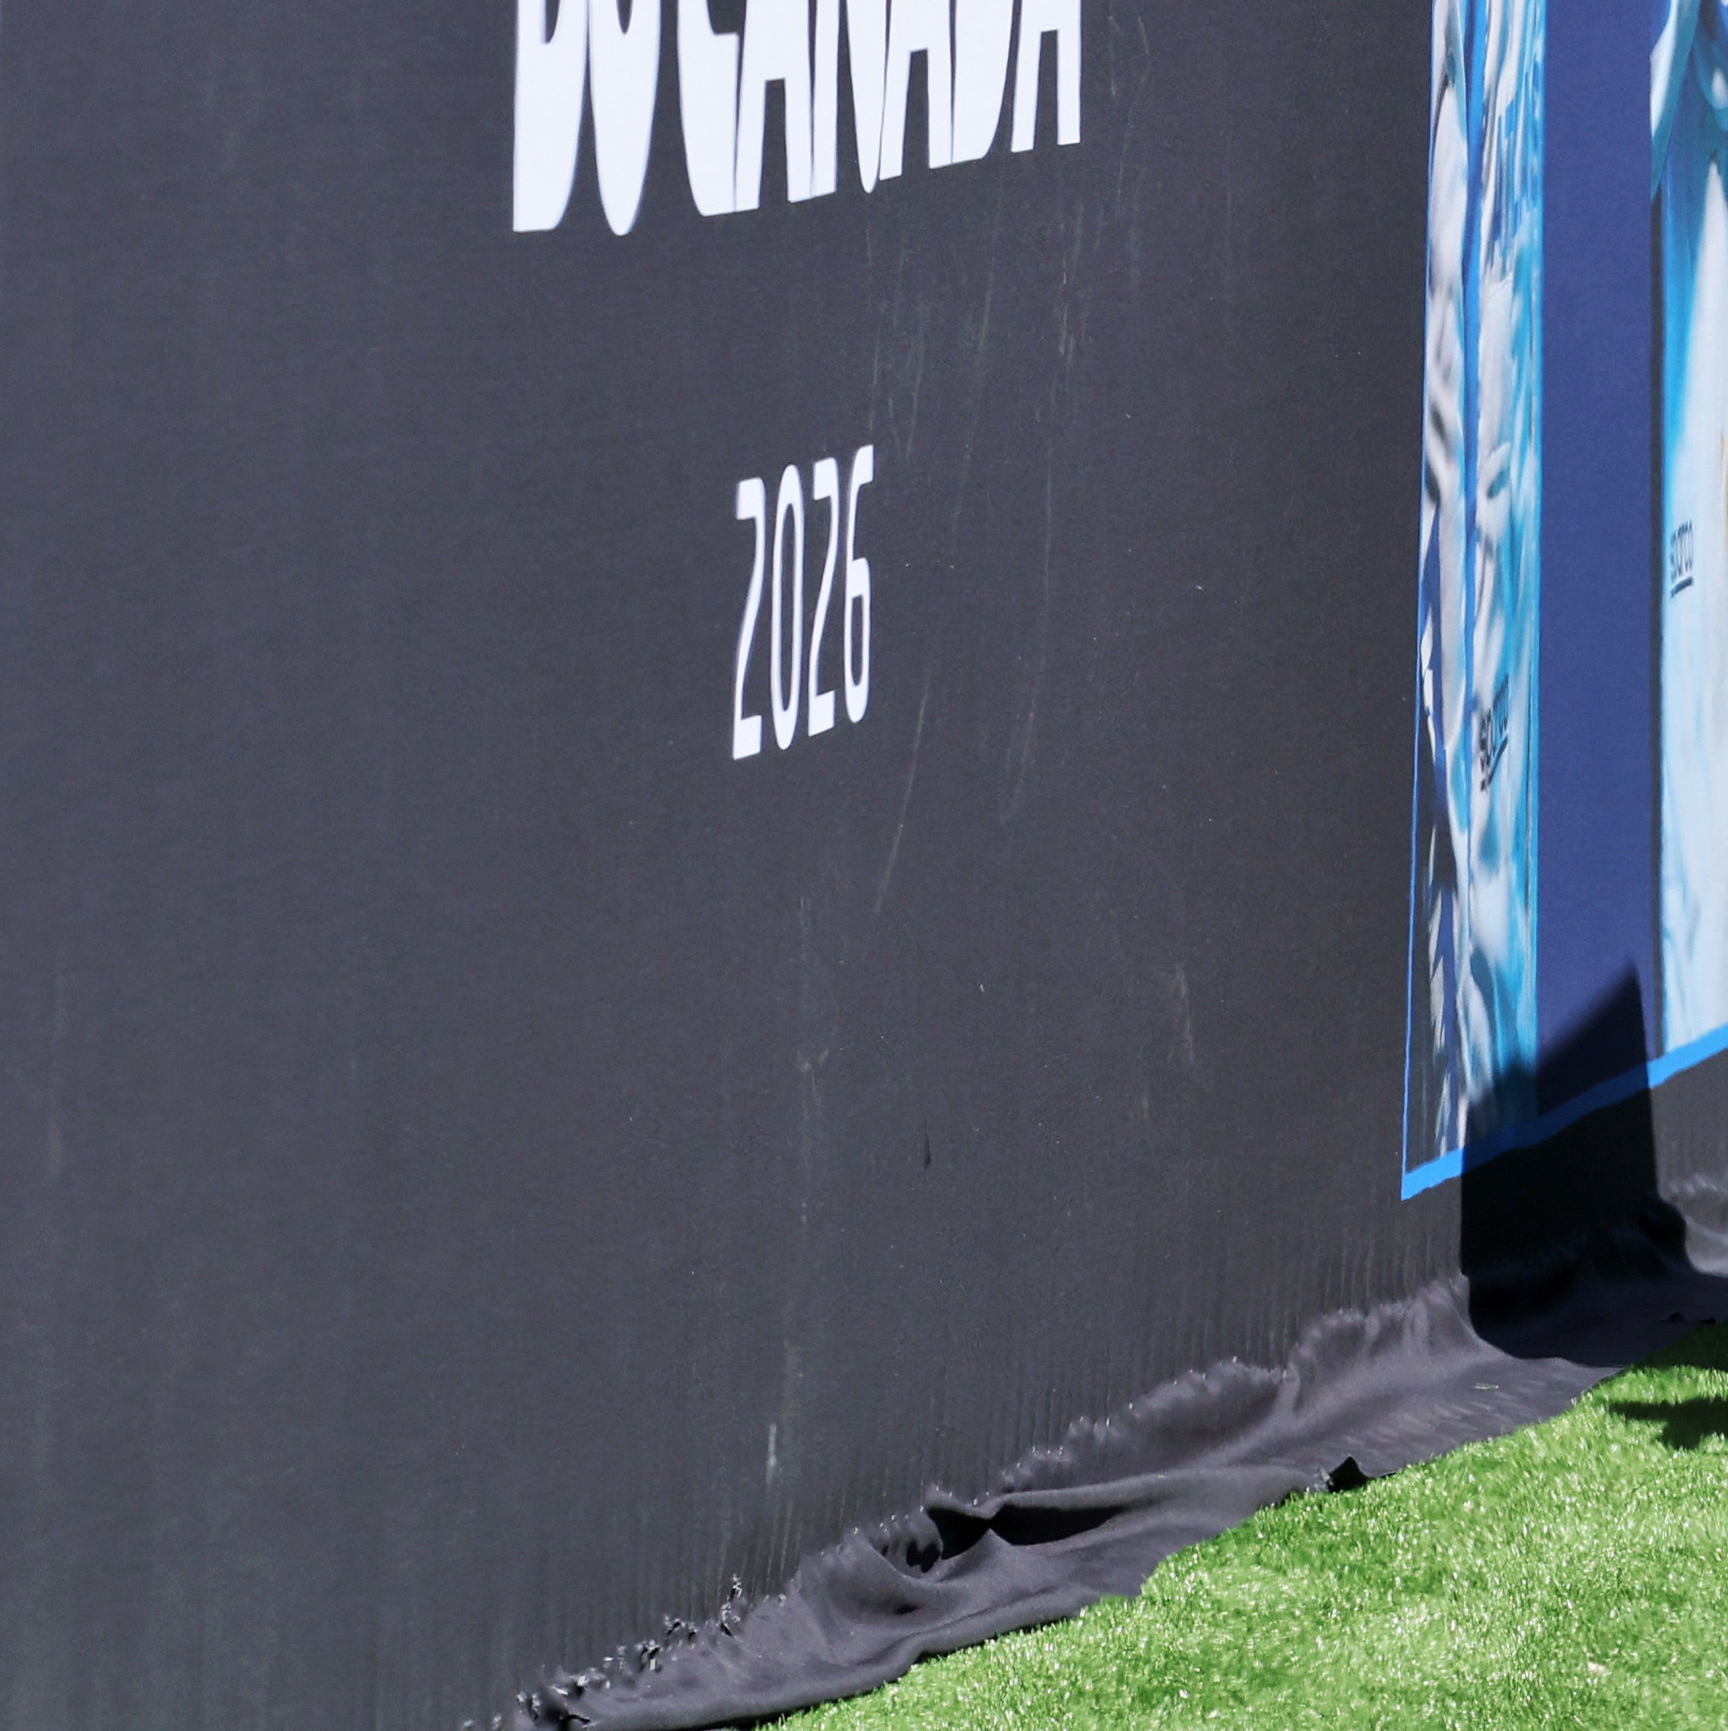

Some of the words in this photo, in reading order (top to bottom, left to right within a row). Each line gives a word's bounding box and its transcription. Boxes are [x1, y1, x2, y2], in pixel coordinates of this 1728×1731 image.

[732, 444, 874, 761] 2026
[1670, 515, 1694, 584] sparco
[1480, 676, 1509, 783] sparco
